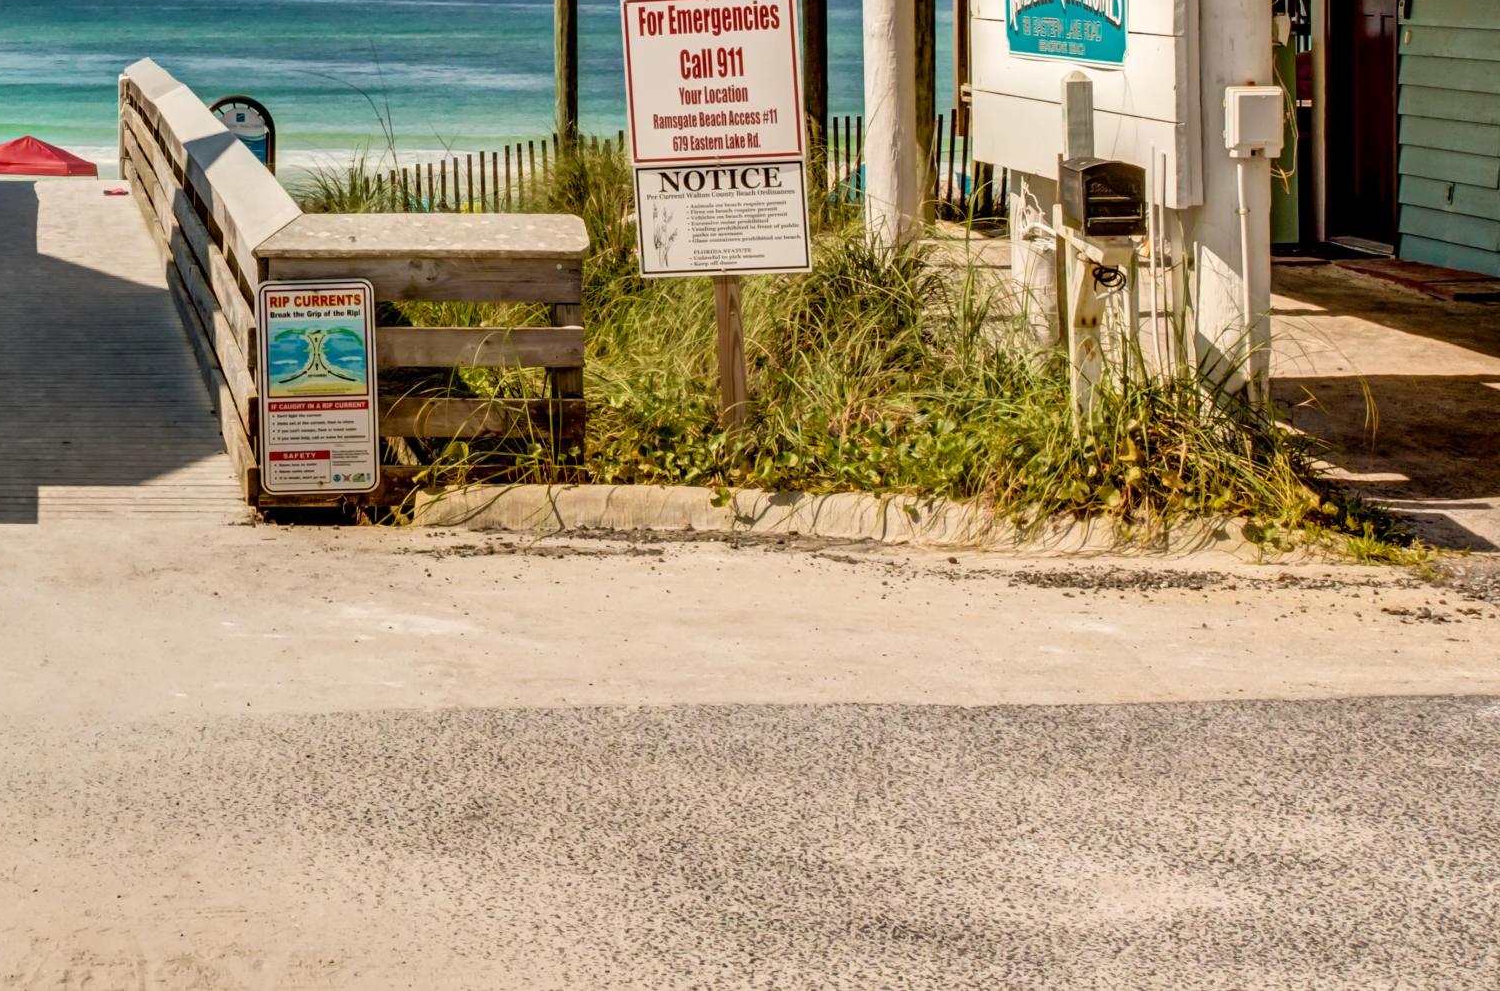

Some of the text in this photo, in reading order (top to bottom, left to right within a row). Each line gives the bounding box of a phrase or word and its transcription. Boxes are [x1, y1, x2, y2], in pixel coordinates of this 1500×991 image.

[638, 0, 780, 36] For Emergencies
[680, 46, 744, 80] Call 911
[679, 85, 748, 105] Your Location
[653, 108, 778, 130] Ramsgate Beach Access #11
[673, 132, 761, 152] 679 Eastern Lake Rd.
[658, 167, 782, 192] NOTICE
[269, 294, 362, 308] RIP CURRENTS
[306, 310, 322, 318] Grip
[347, 309, 361, 317] Rip!
